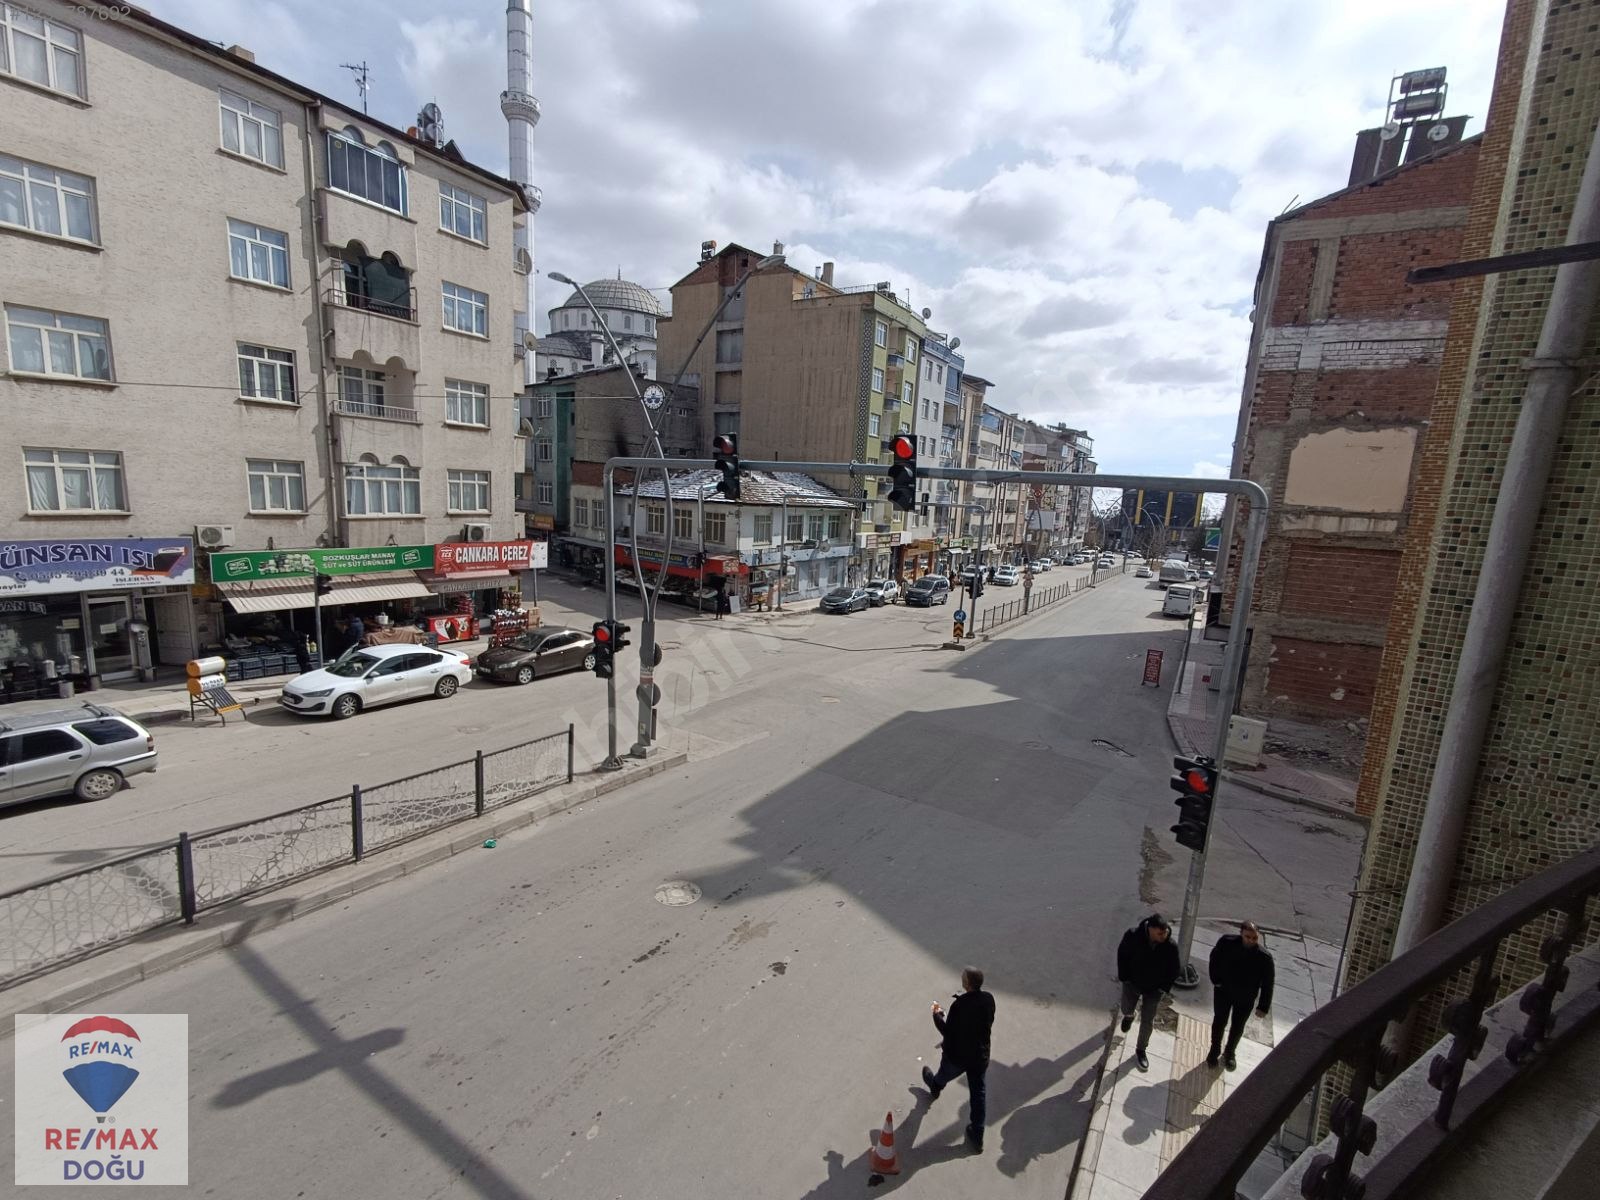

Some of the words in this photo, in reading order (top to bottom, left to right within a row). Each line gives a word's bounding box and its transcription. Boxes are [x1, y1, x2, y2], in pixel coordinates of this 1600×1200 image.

[456, 546, 500, 563] CANKARA
[502, 545, 529, 563] ÇEREZ
[362, 558, 396, 566] ÜRÜNLERİ
